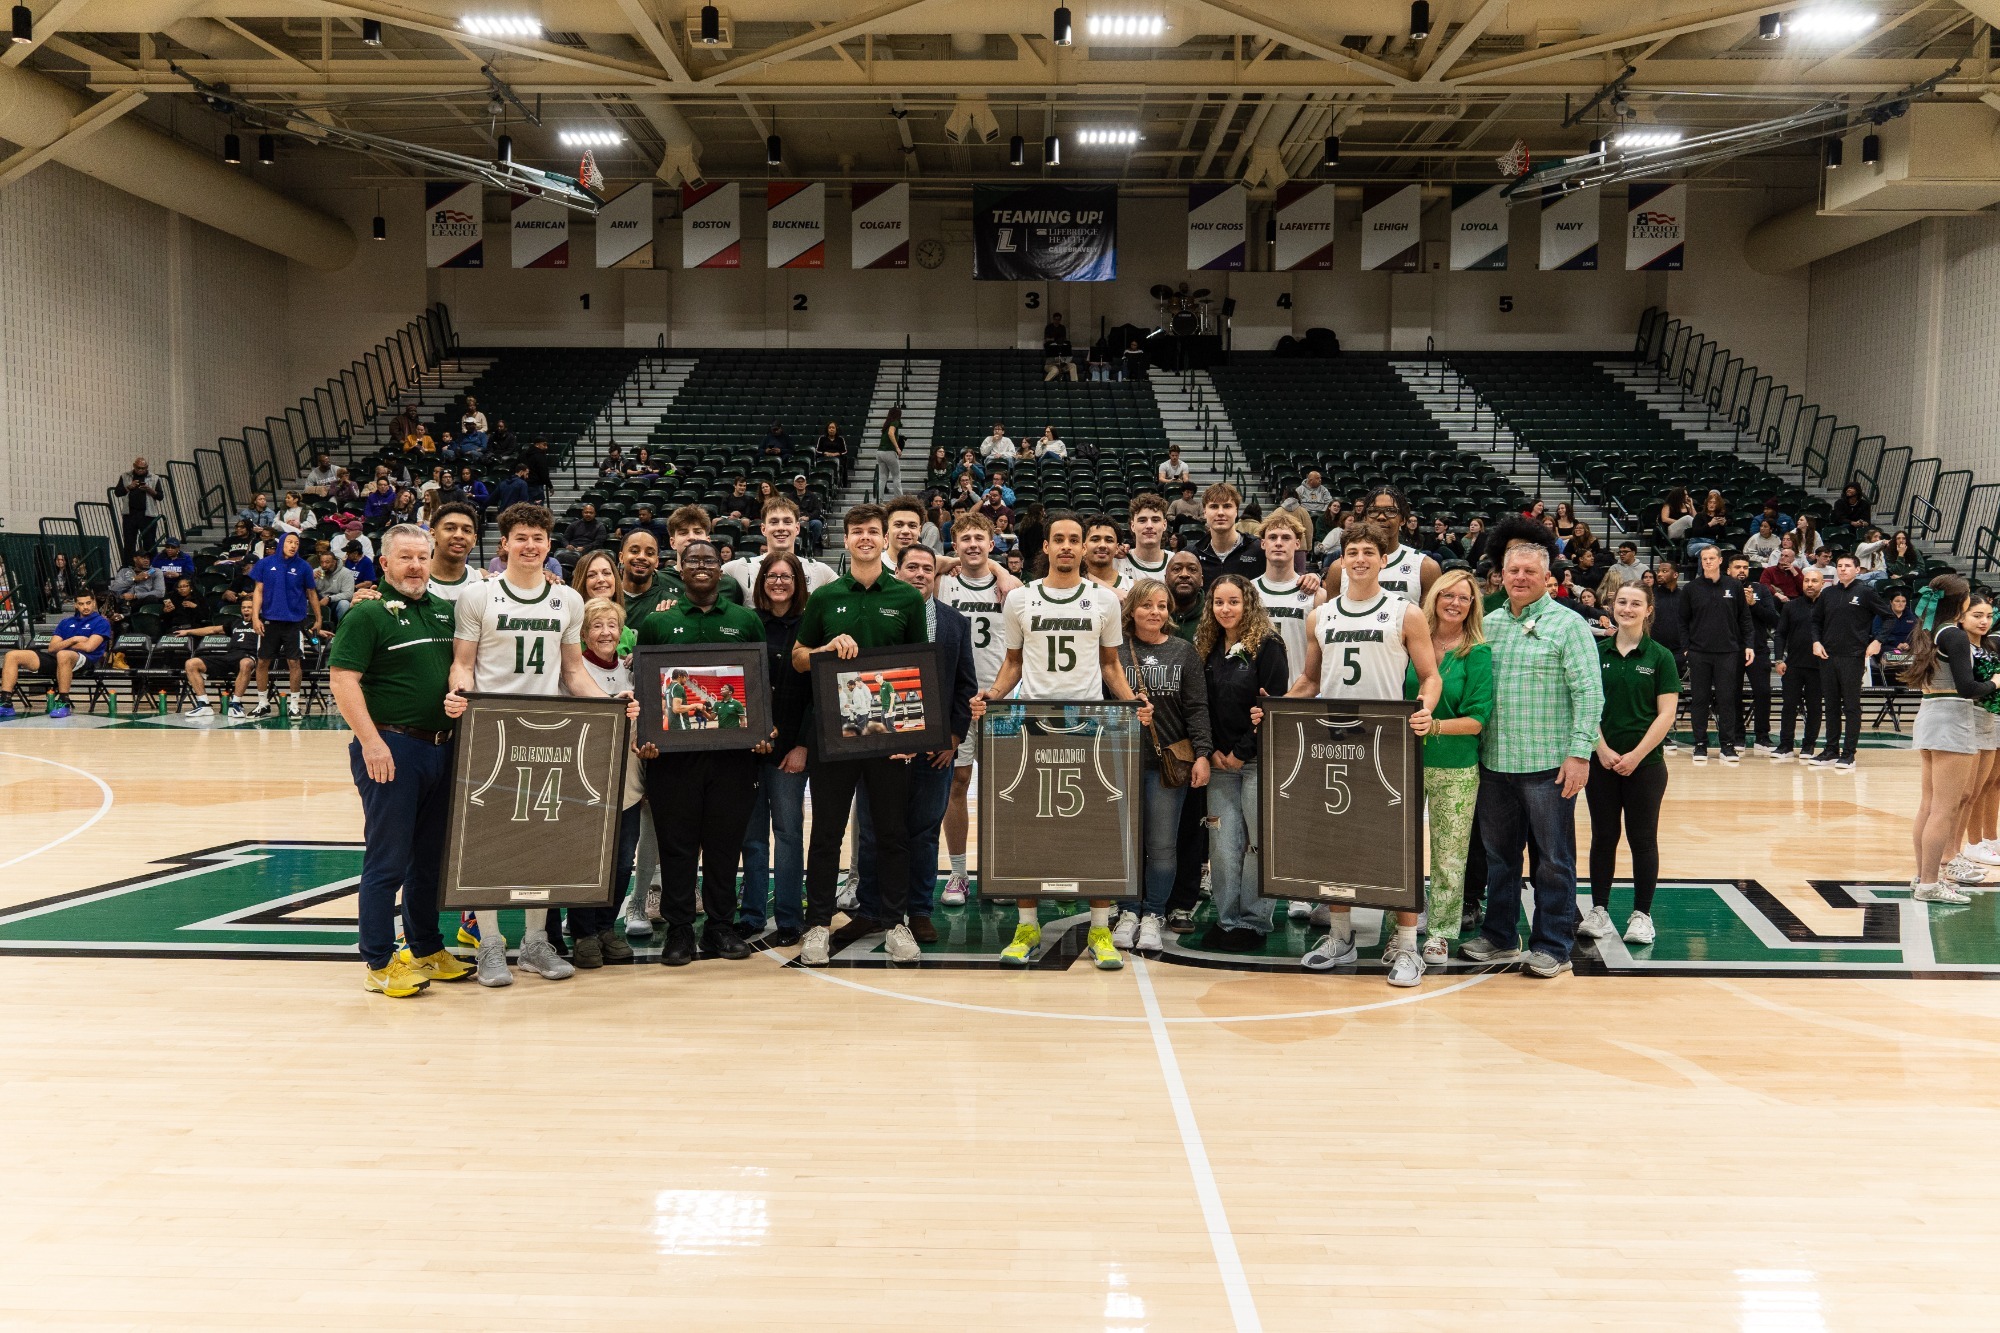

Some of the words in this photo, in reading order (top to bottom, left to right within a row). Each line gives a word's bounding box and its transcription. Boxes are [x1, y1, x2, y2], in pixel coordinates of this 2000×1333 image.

[514, 220, 566, 230] AMERICAN
[610, 220, 639, 230] ARMY
[692, 220, 731, 230] BOSTON
[772, 220, 820, 230] BUCKNELL
[859, 221, 902, 230] COLGATE
[992, 210, 1071, 224] TEAMING
[1076, 210, 1104, 225] UP!
[1049, 228, 1099, 236] LIFEBRIDGE
[1190, 222, 1214, 231] HOLY
[1215, 222, 1244, 231] CROSS
[1279, 222, 1331, 231] LAFAYETTE
[1373, 222, 1409, 231] LEHIGH
[1461, 222, 1499, 231] LOYOLA
[1556, 222, 1584, 231] NAVY
[1632, 231, 1680, 239] LEAGUE
[996, 228, 1017, 253] L
[579, 293, 590, 310] 1
[793, 294, 808, 311] 2
[1025, 292, 1040, 309] 3
[1276, 293, 1293, 310] 4
[1499, 295, 1514, 312] 5
[496, 613, 561, 632] LOYOLA
[1030, 614, 1093, 632] LOYOLA
[237, 632, 245, 642] 2
[1325, 628, 1384, 645] LOYOLA
[514, 635, 546, 675] 14
[1046, 635, 1077, 672] 15
[1342, 647, 1362, 686] 5
[1126, 664, 1181, 691] OYOLA
[511, 746, 572, 763] BRENNAN
[1035, 748, 1086, 764] COMMANDER
[1311, 744, 1365, 759] SPOSITO
[511, 766, 563, 822] 14
[1036, 768, 1085, 818] 15
[1325, 763, 1351, 815] 5
